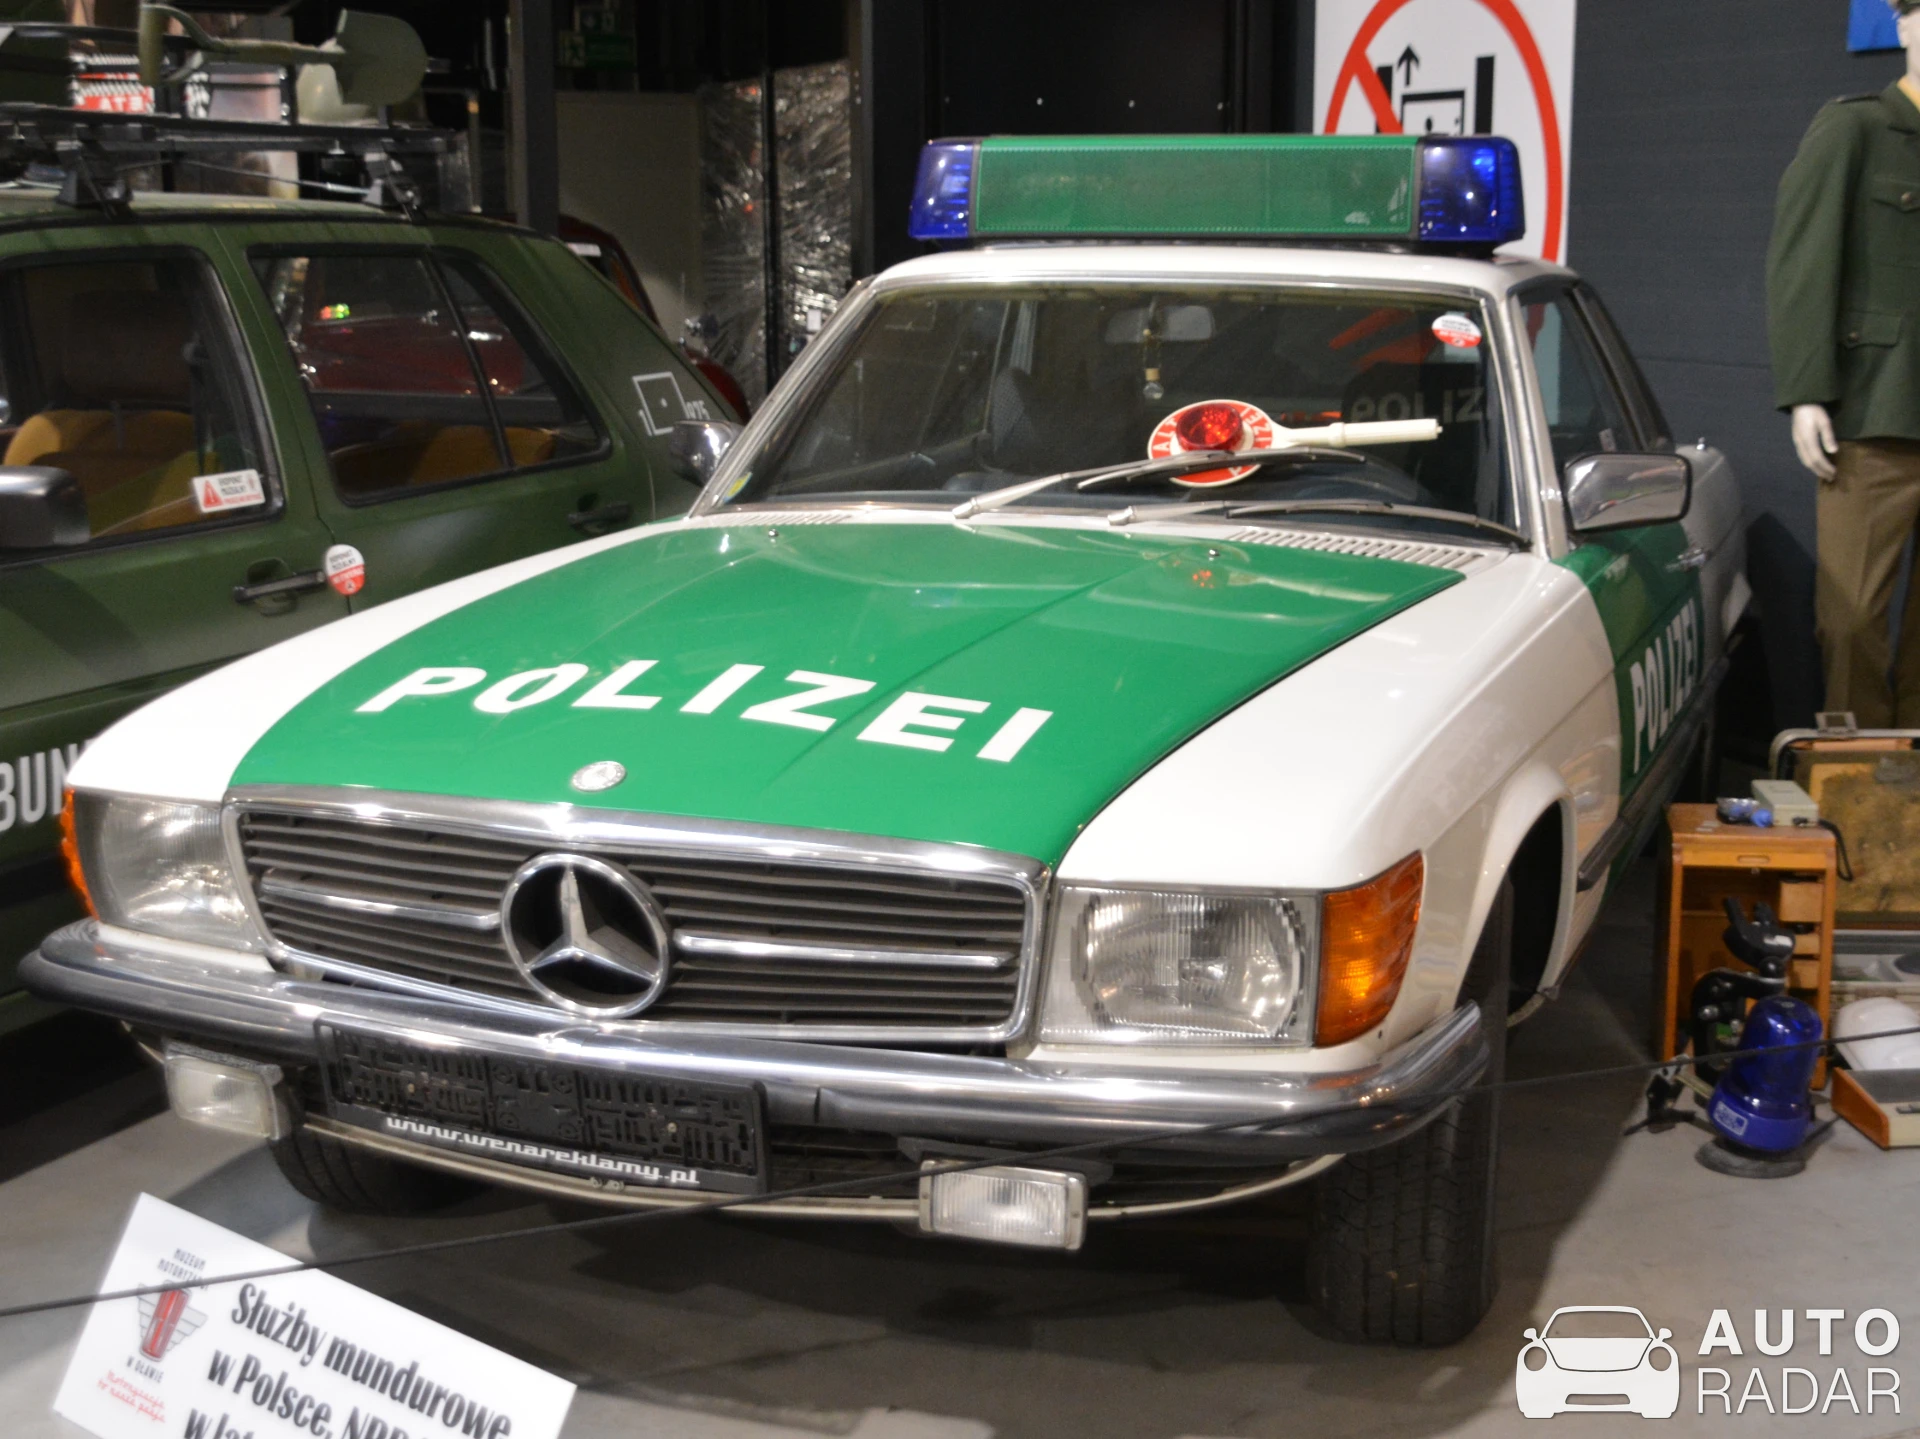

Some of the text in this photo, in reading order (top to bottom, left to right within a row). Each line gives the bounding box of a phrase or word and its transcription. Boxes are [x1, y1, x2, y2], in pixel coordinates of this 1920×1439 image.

[353, 659, 1055, 763] POLIZEI
[1629, 597, 1699, 775] POLIZEI
[0, 739, 96, 832] BUN
[174, 1248, 206, 1271] MUZEUM
[207, 1349, 237, 1388] w
[232, 1352, 334, 1439] Polsce,
[231, 1282, 513, 1439] Służby mundurowe
